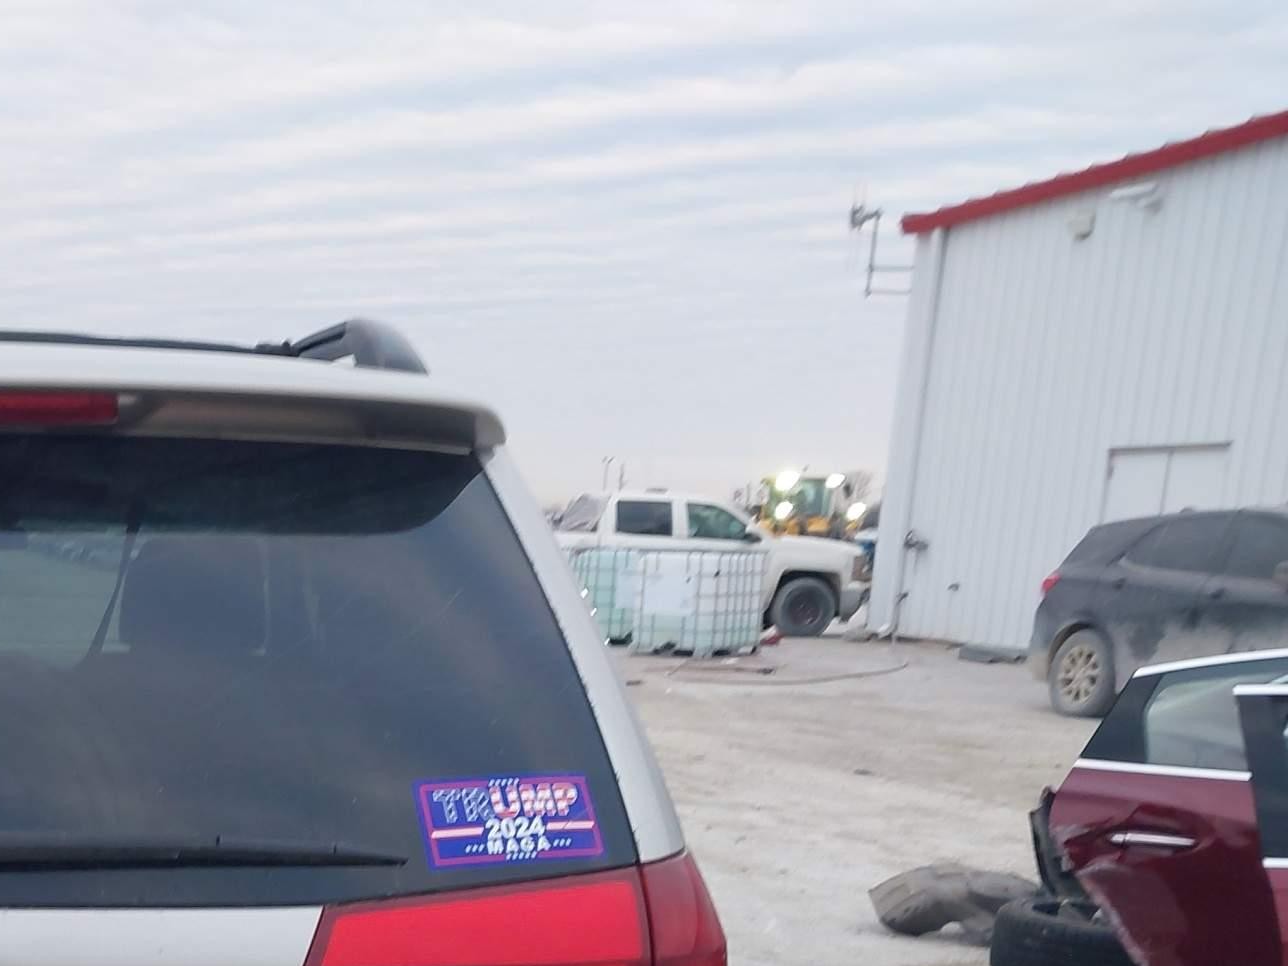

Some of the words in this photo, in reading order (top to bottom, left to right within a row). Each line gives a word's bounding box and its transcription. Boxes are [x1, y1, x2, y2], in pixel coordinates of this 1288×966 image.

[432, 783, 578, 823] TRUMP
[485, 817, 545, 839] 2024
[487, 836, 550, 855] MAGA
